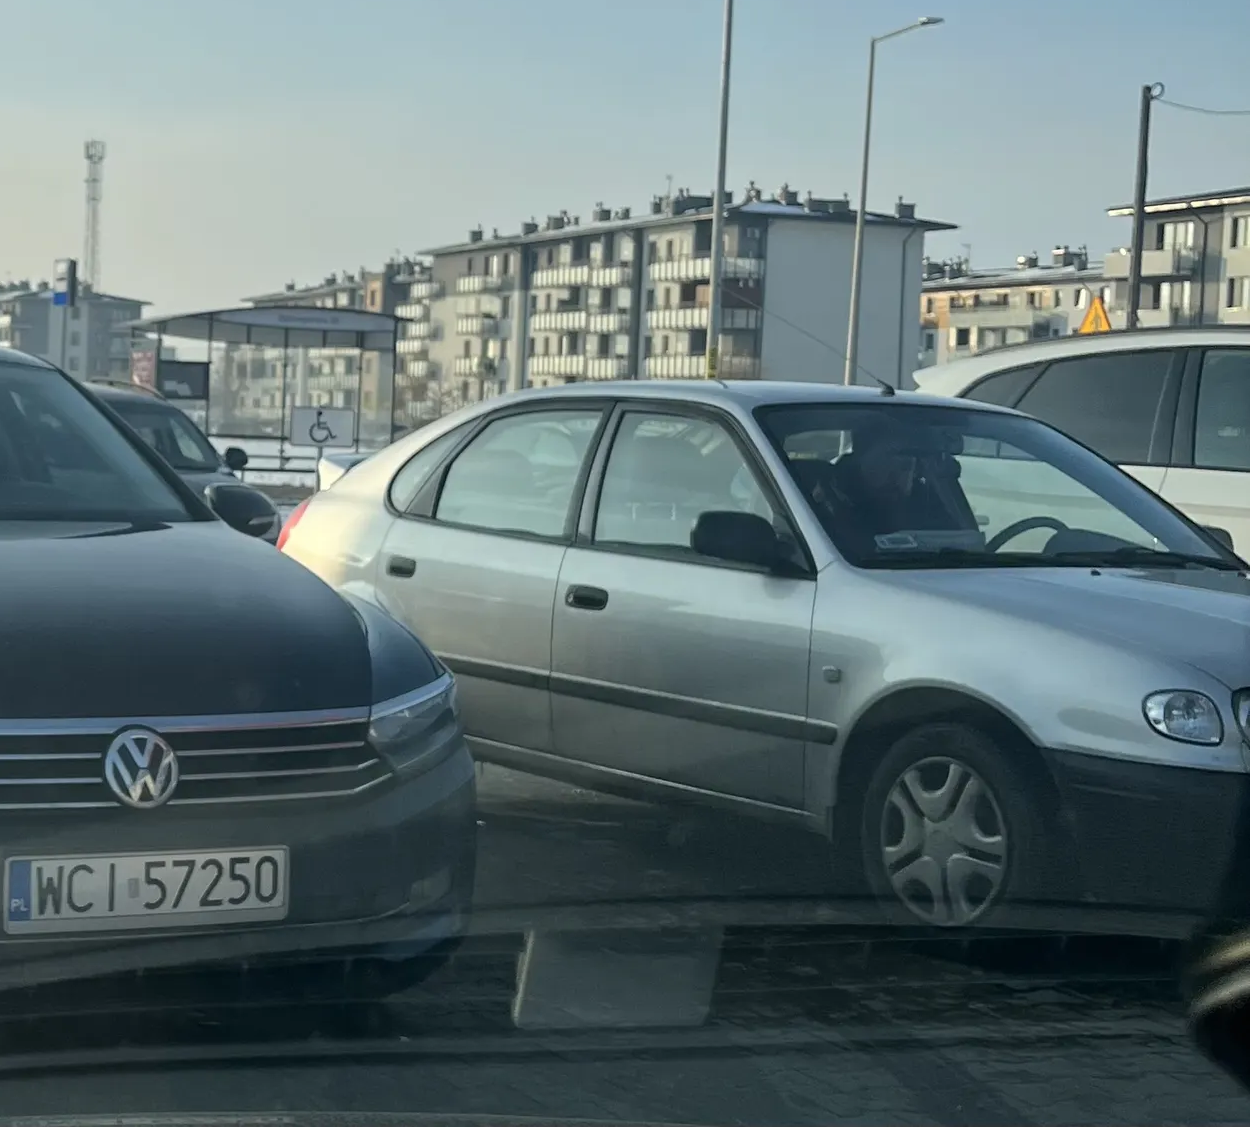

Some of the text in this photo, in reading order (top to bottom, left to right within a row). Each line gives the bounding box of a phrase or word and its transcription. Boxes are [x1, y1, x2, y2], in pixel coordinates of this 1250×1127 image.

[36, 855, 279, 915] WCI 57250
[10, 897, 30, 912] PL
